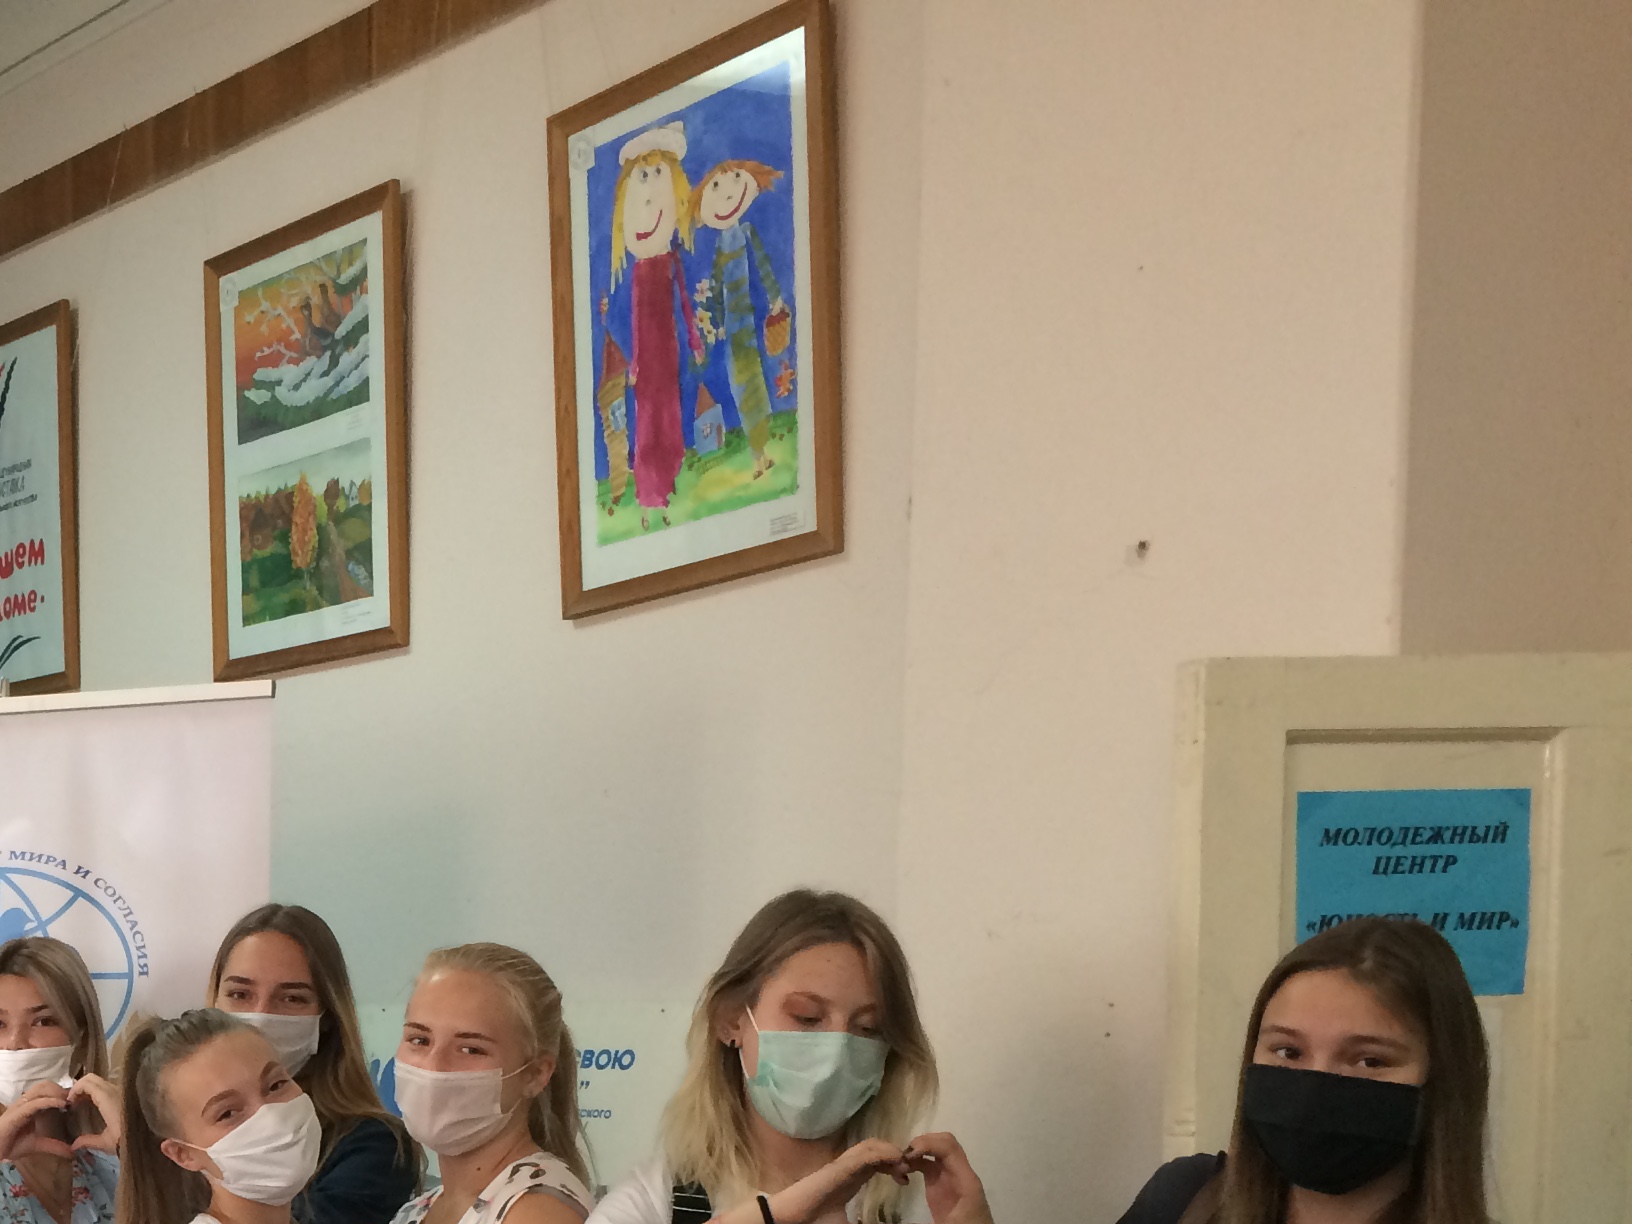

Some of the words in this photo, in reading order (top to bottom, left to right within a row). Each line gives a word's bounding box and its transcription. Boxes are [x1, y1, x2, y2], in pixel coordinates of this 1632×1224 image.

[1319, 821, 1510, 848] МОЛОДЕЖНЫЙ
[1372, 854, 1459, 876] ЦЕНТР
[8, 850, 68, 871] МИРА
[72, 865, 93, 880] И
[93, 877, 150, 978] СОГЛАСИЯ
[1453, 911, 1520, 931] МИР»
